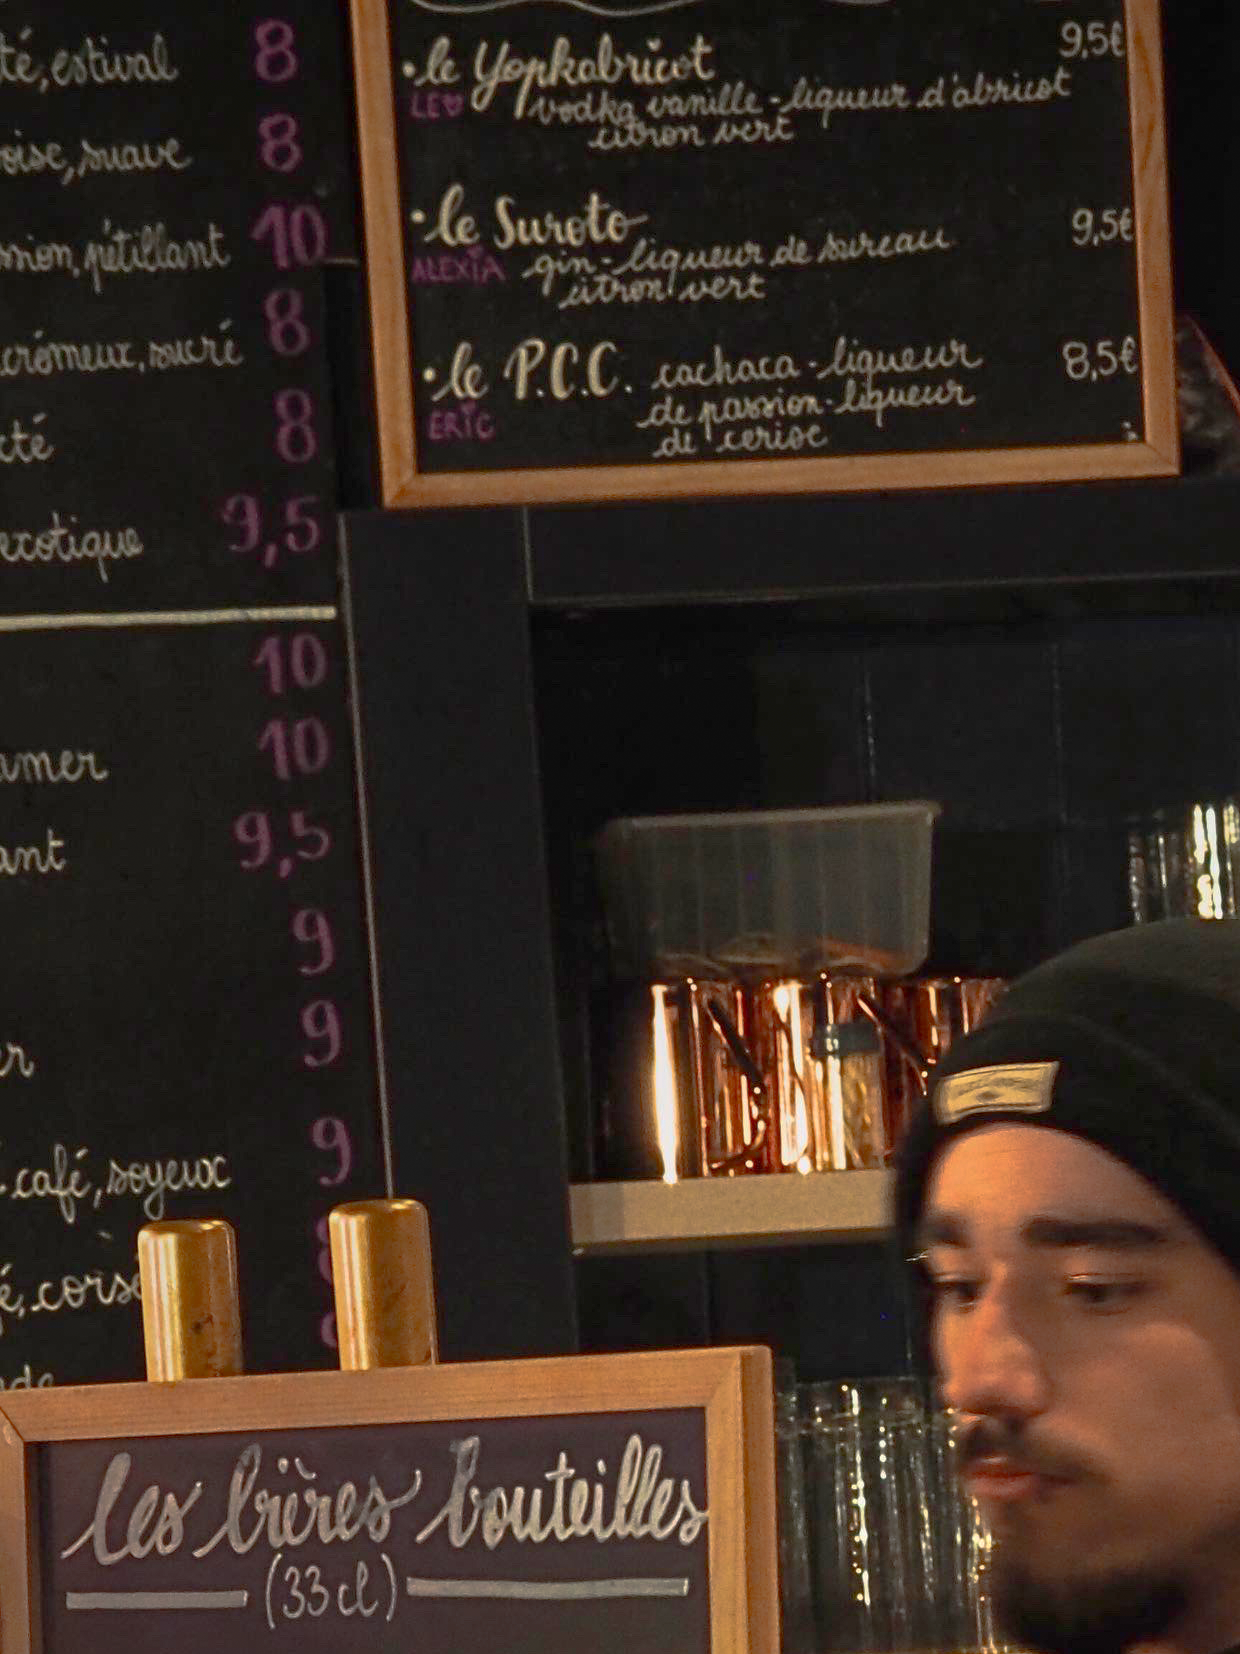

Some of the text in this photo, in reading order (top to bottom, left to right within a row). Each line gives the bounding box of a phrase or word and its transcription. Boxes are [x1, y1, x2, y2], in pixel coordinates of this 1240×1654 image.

[254, 17, 298, 83] 8
[414, 36, 461, 87] le
[529, 93, 638, 130] vodka
[647, 81, 763, 117] vanille
[589, 116, 795, 150] citron vert
[258, 112, 300, 174] 8
[250, 203, 326, 272] 10
[424, 183, 480, 247] le
[494, 191, 649, 250] Suroto
[522, 227, 954, 296] gin liqueur de sureau
[559, 271, 767, 310] citron vert
[264, 287, 310, 357] 8
[432, 341, 489, 400] le
[504, 337, 634, 401] P.C.C.
[817, 335, 984, 394] liqueur
[1062, 335, 1139, 382] 8,5€
[274, 387, 317, 464] 8
[636, 379, 977, 442] de passion liqueur
[652, 421, 829, 459] de cerise
[220, 494, 321, 569] 9,5
[252, 632, 329, 695] 10
[257, 716, 331, 781] 10
[233, 809, 332, 879] 9,5
[291, 907, 337, 976] 9
[301, 999, 343, 1068] 9
[310, 1114, 353, 1186] 9
[61, 1433, 710, 1565] Les bières bouteilles
